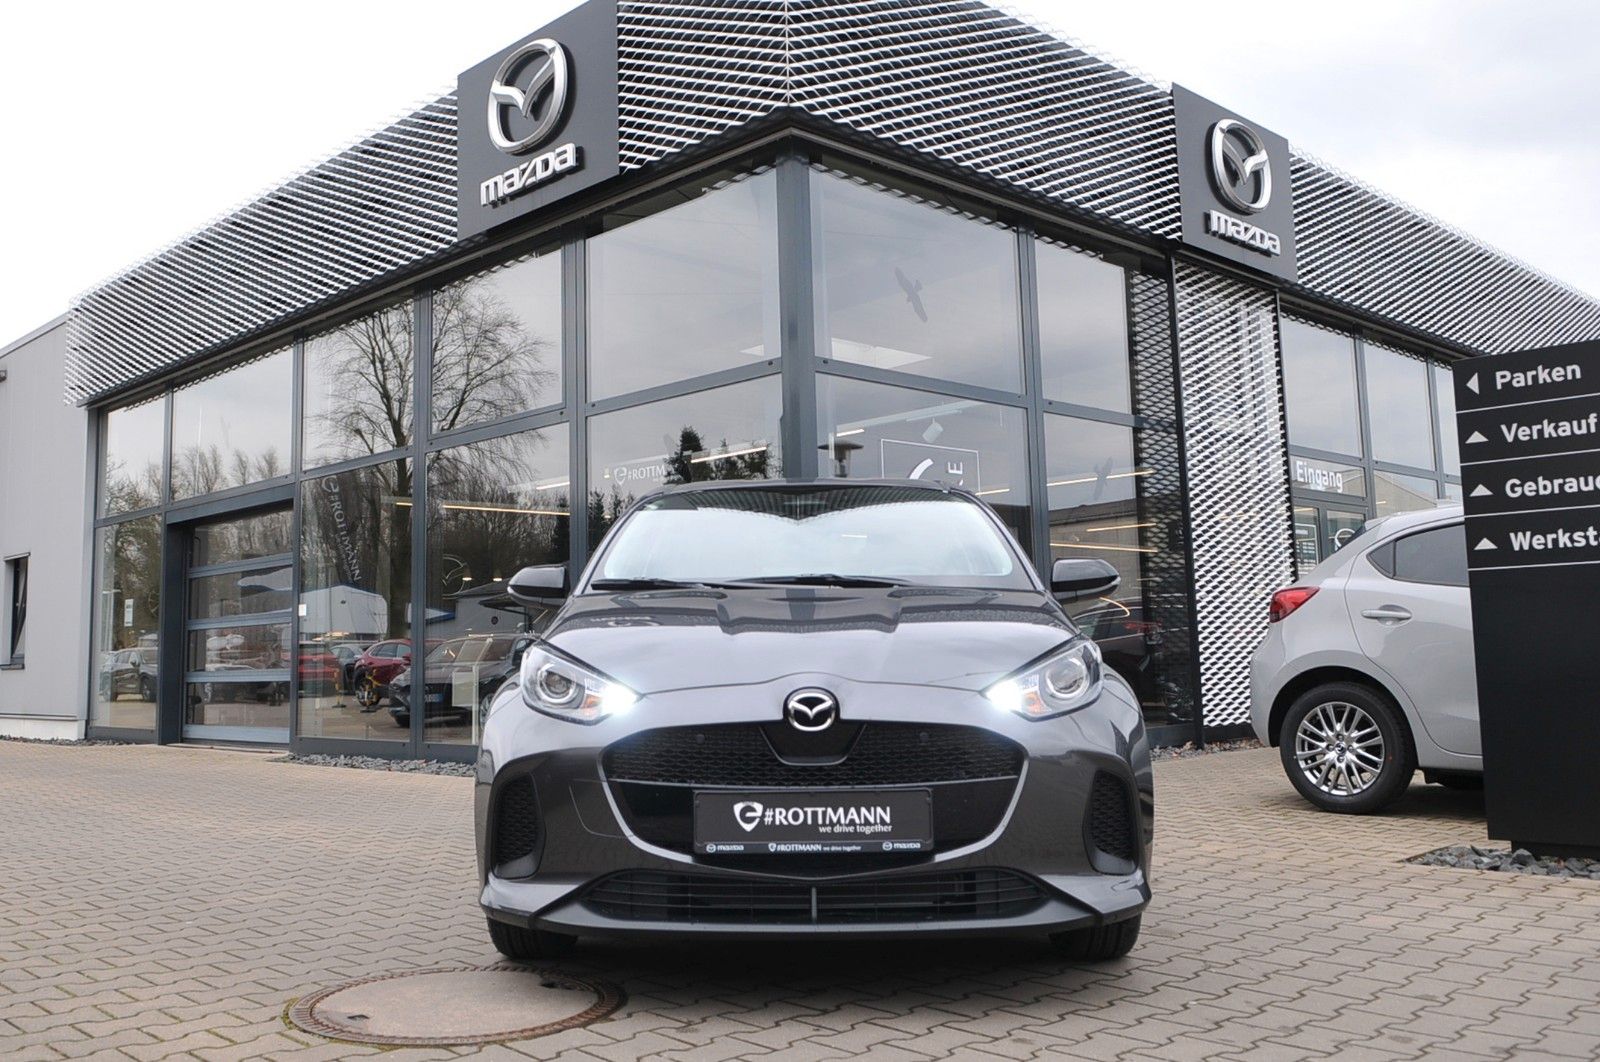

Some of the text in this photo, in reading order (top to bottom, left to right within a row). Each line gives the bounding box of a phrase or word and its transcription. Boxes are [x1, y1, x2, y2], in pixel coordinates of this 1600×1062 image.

[1495, 363, 1582, 390] Parken
[1501, 412, 1598, 443] Verkauf
[1295, 461, 1343, 493] Eingang
[1509, 525, 1600, 551] Werkst
[764, 806, 891, 826] #ROTTMANN
[818, 823, 893, 835] we drive together
